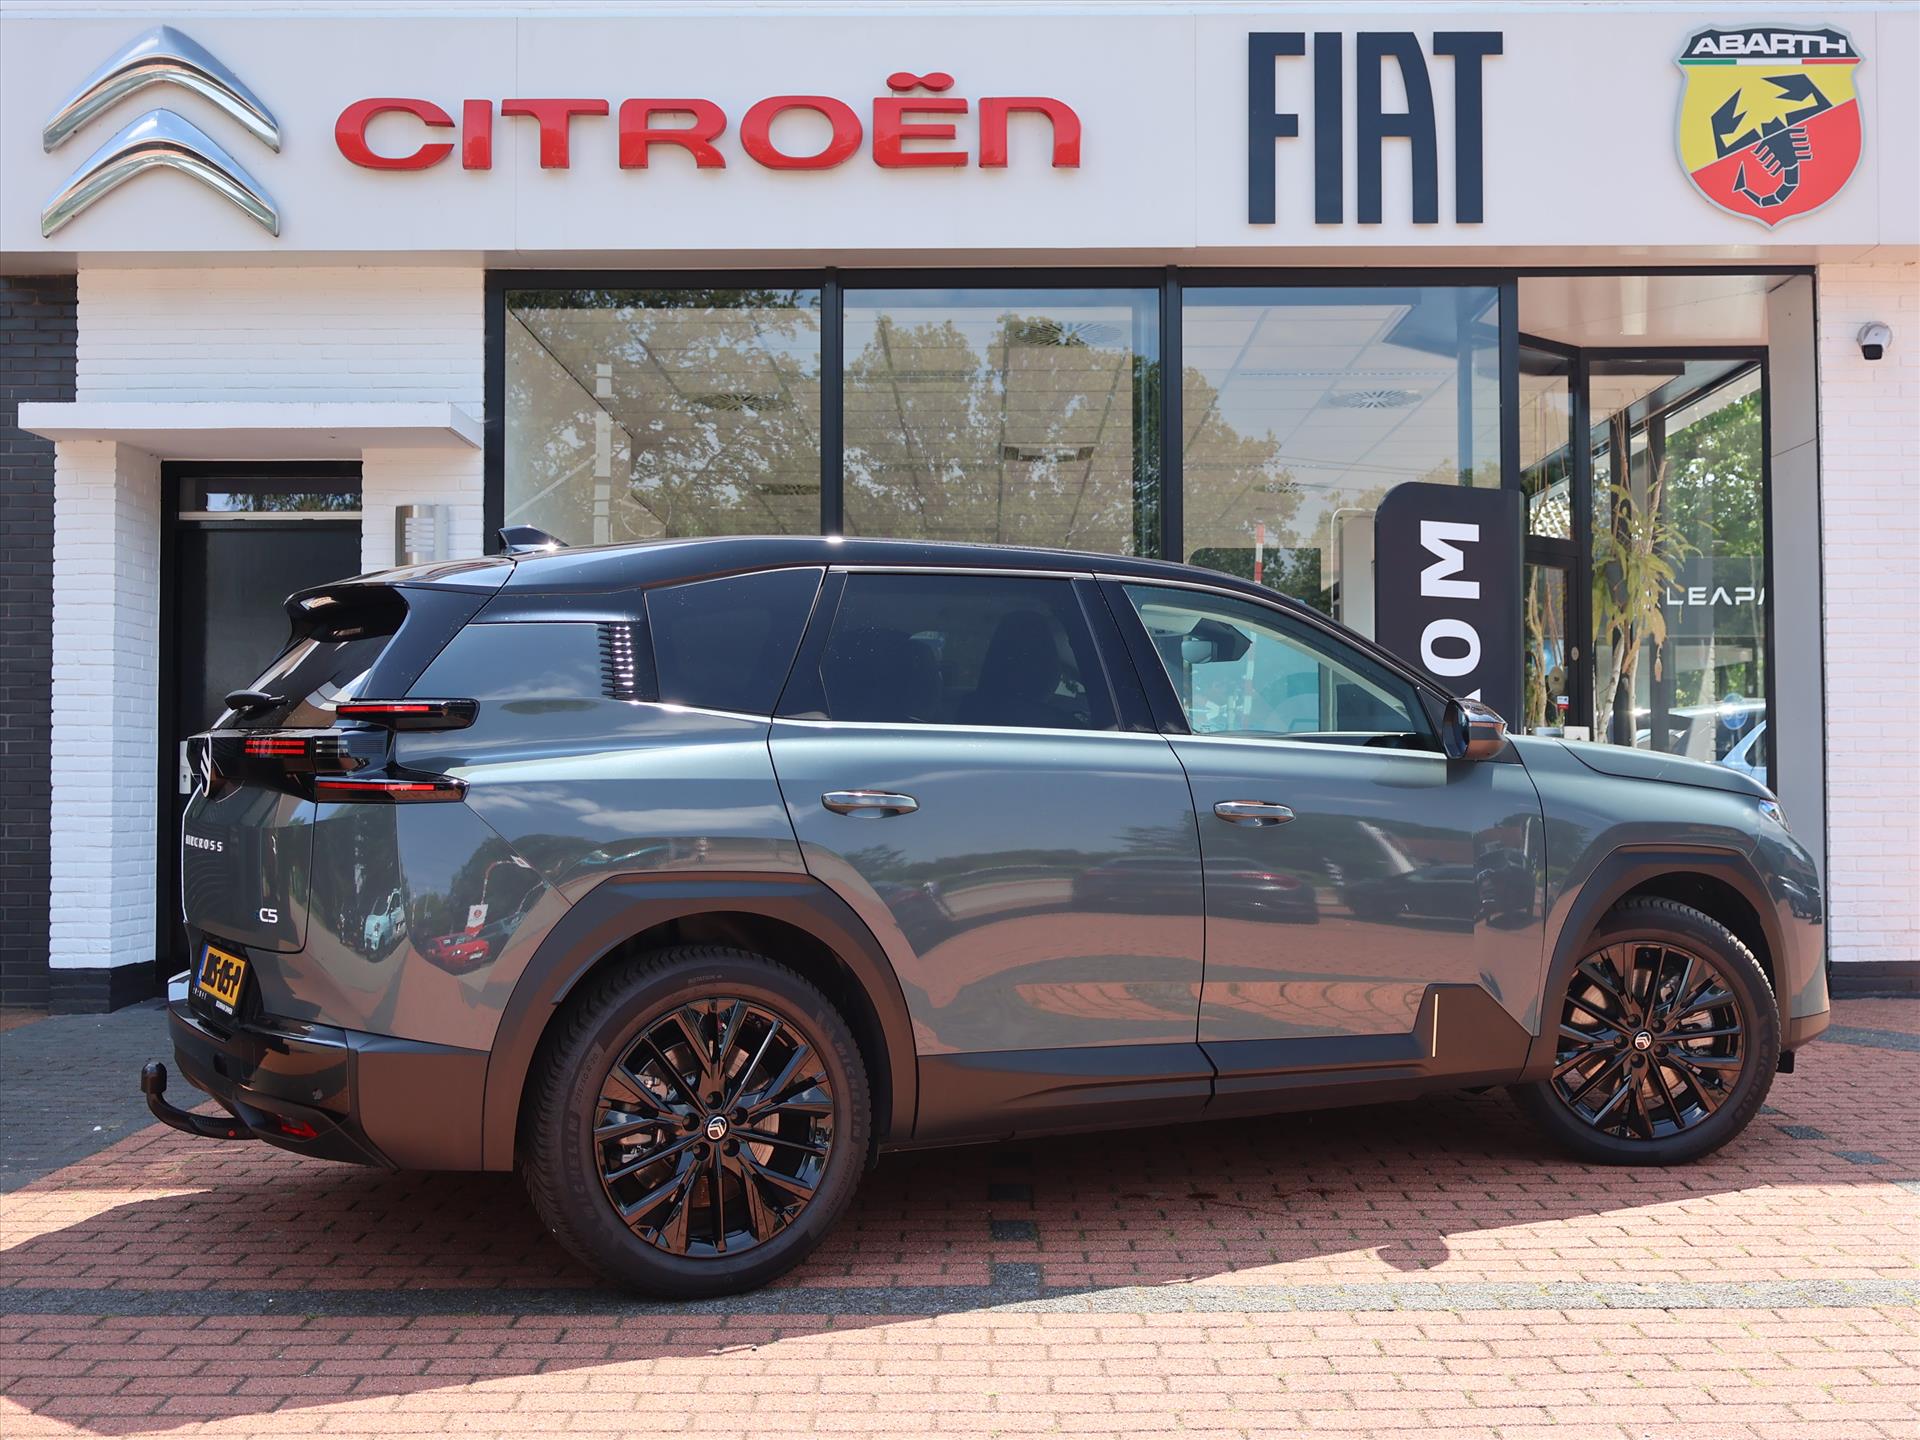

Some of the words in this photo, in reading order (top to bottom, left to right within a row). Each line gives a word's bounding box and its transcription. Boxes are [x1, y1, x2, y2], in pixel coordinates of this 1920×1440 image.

[1691, 33, 1847, 55] ABARTH
[334, 71, 1082, 171] CITROËN
[1248, 31, 1503, 225] FIAT
[1420, 519, 1482, 702] OM
[259, 907, 278, 923] C5
